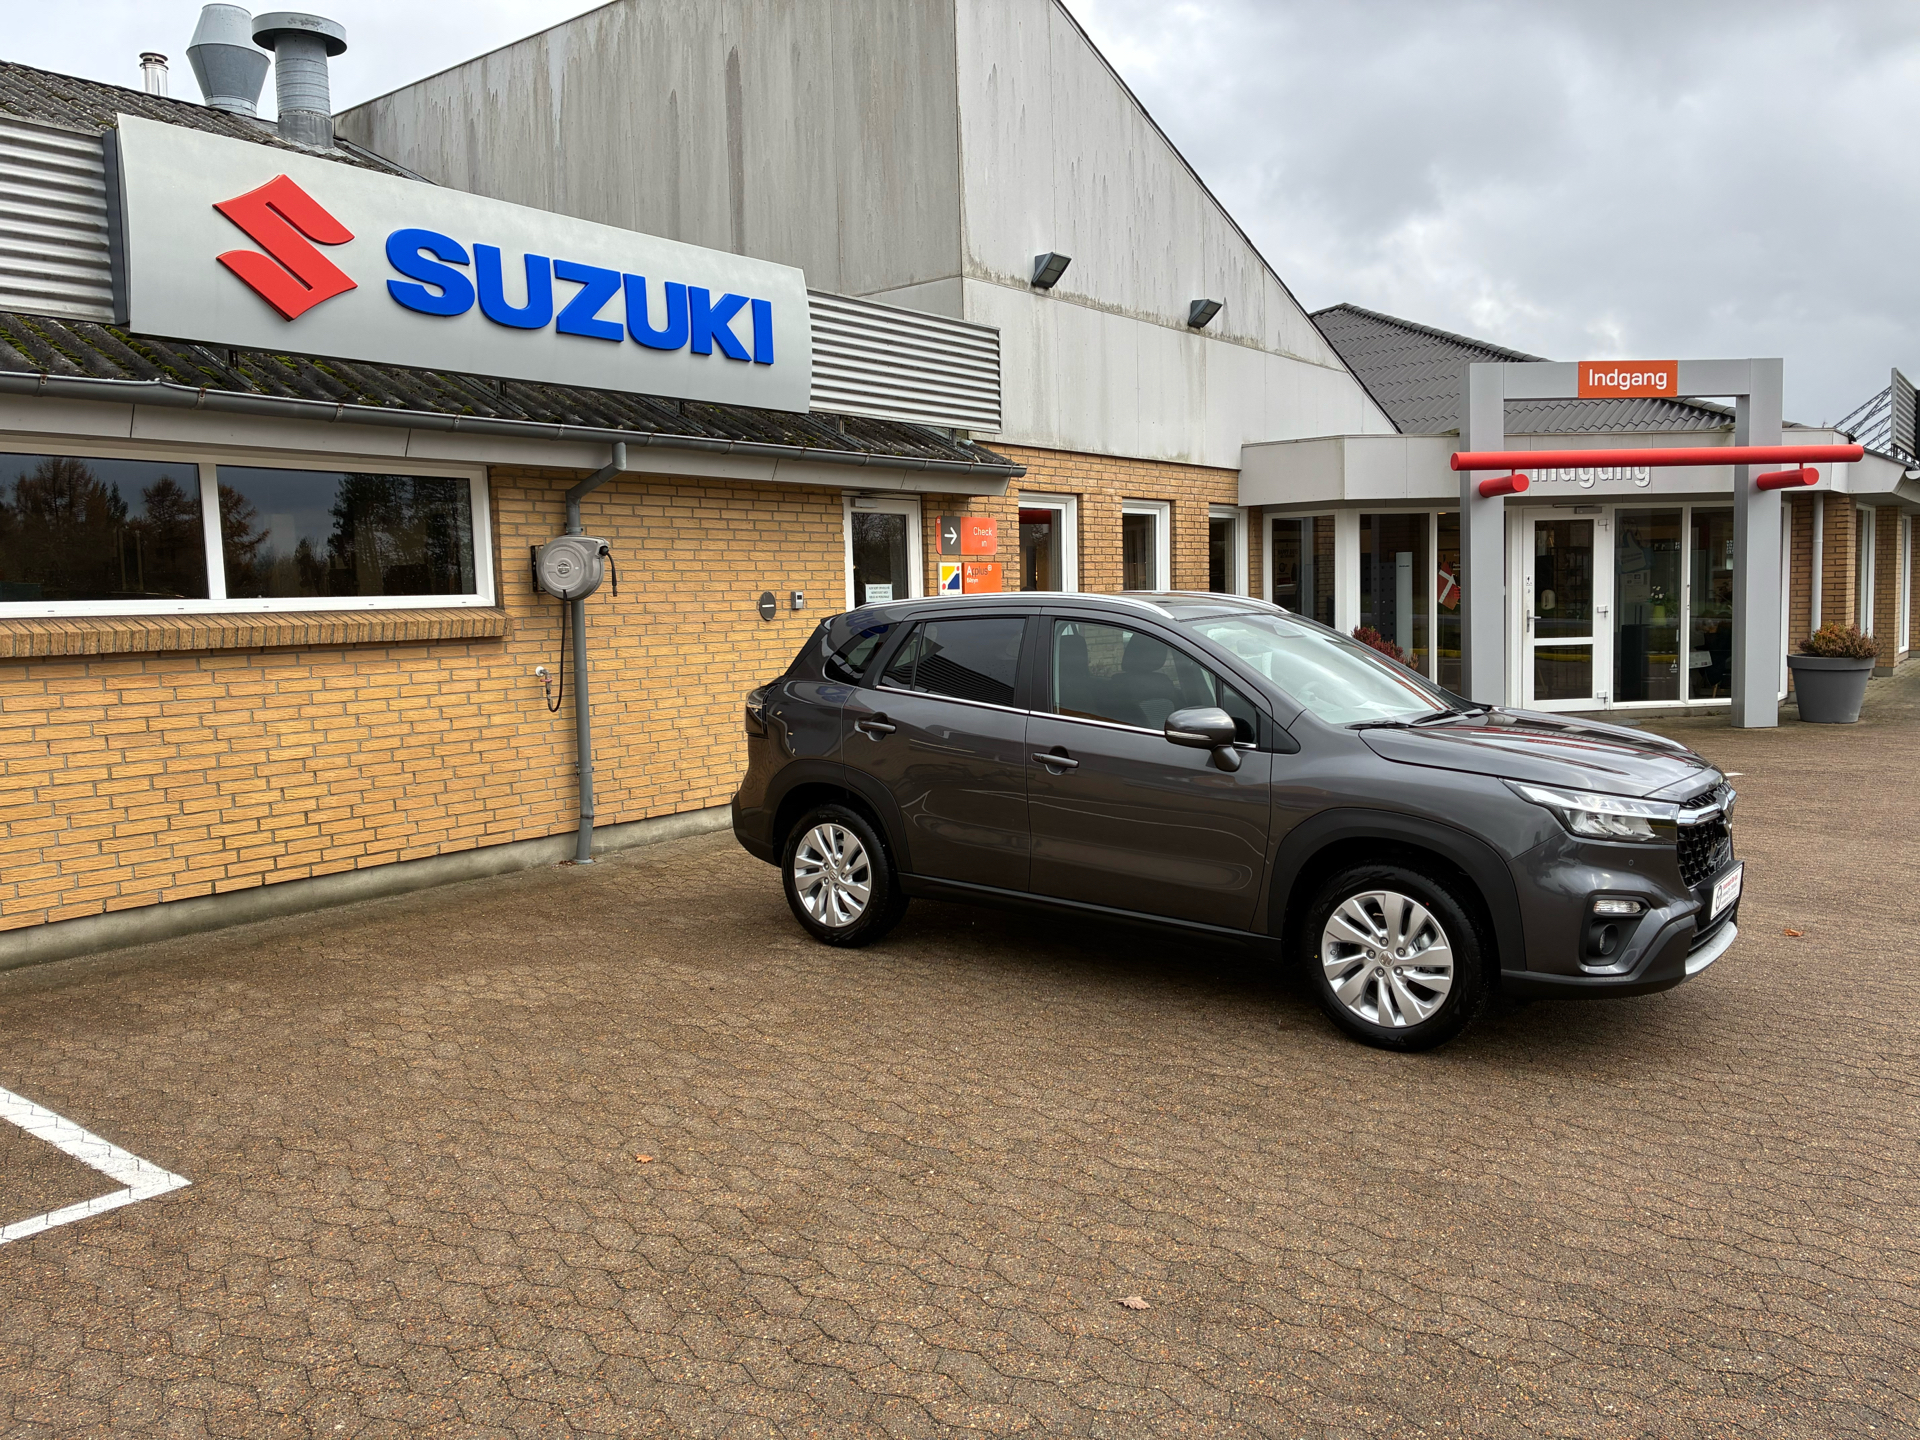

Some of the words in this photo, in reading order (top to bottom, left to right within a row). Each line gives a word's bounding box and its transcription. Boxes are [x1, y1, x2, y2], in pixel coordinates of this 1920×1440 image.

[386, 228, 775, 366] SUZUKI
[1588, 368, 1668, 391] Indgang
[973, 526, 993, 536] Check
